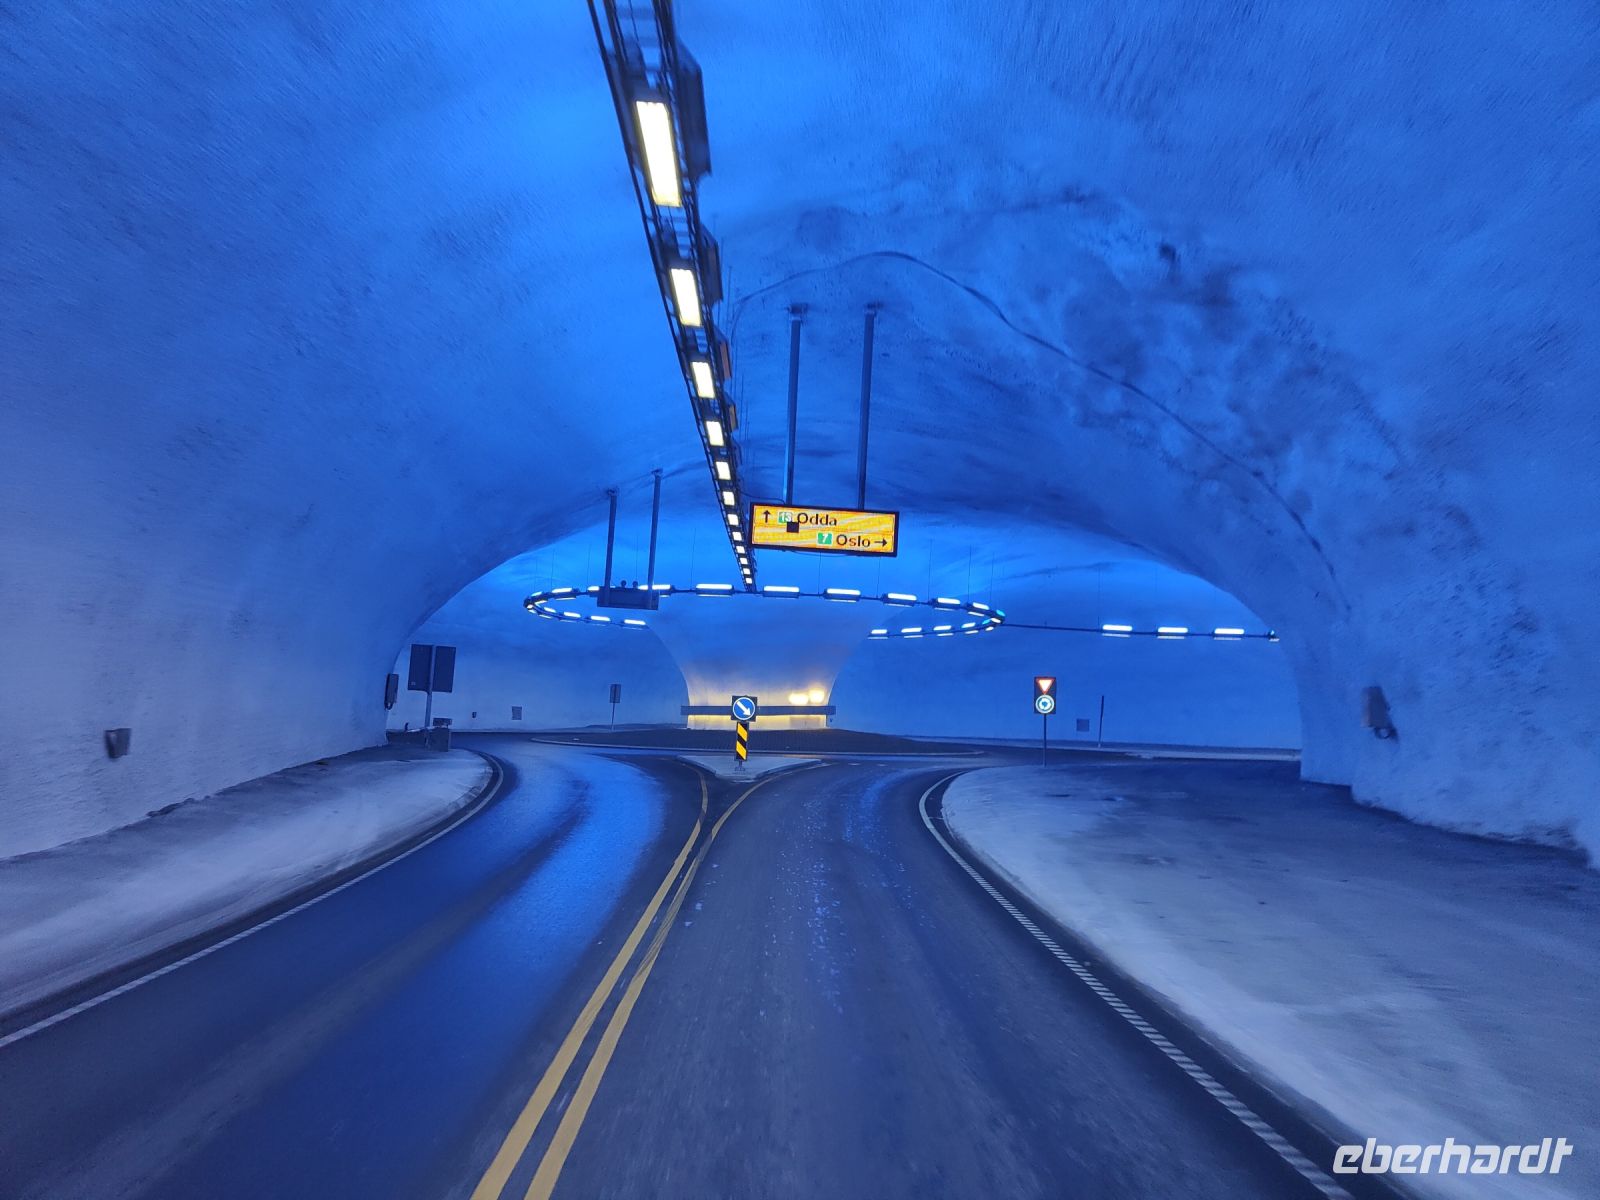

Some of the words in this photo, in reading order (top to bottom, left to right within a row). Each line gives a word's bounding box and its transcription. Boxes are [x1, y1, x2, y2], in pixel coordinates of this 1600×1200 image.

[797, 512, 837, 526] Odda
[821, 534, 829, 543] 7
[836, 534, 871, 548] Oslo
